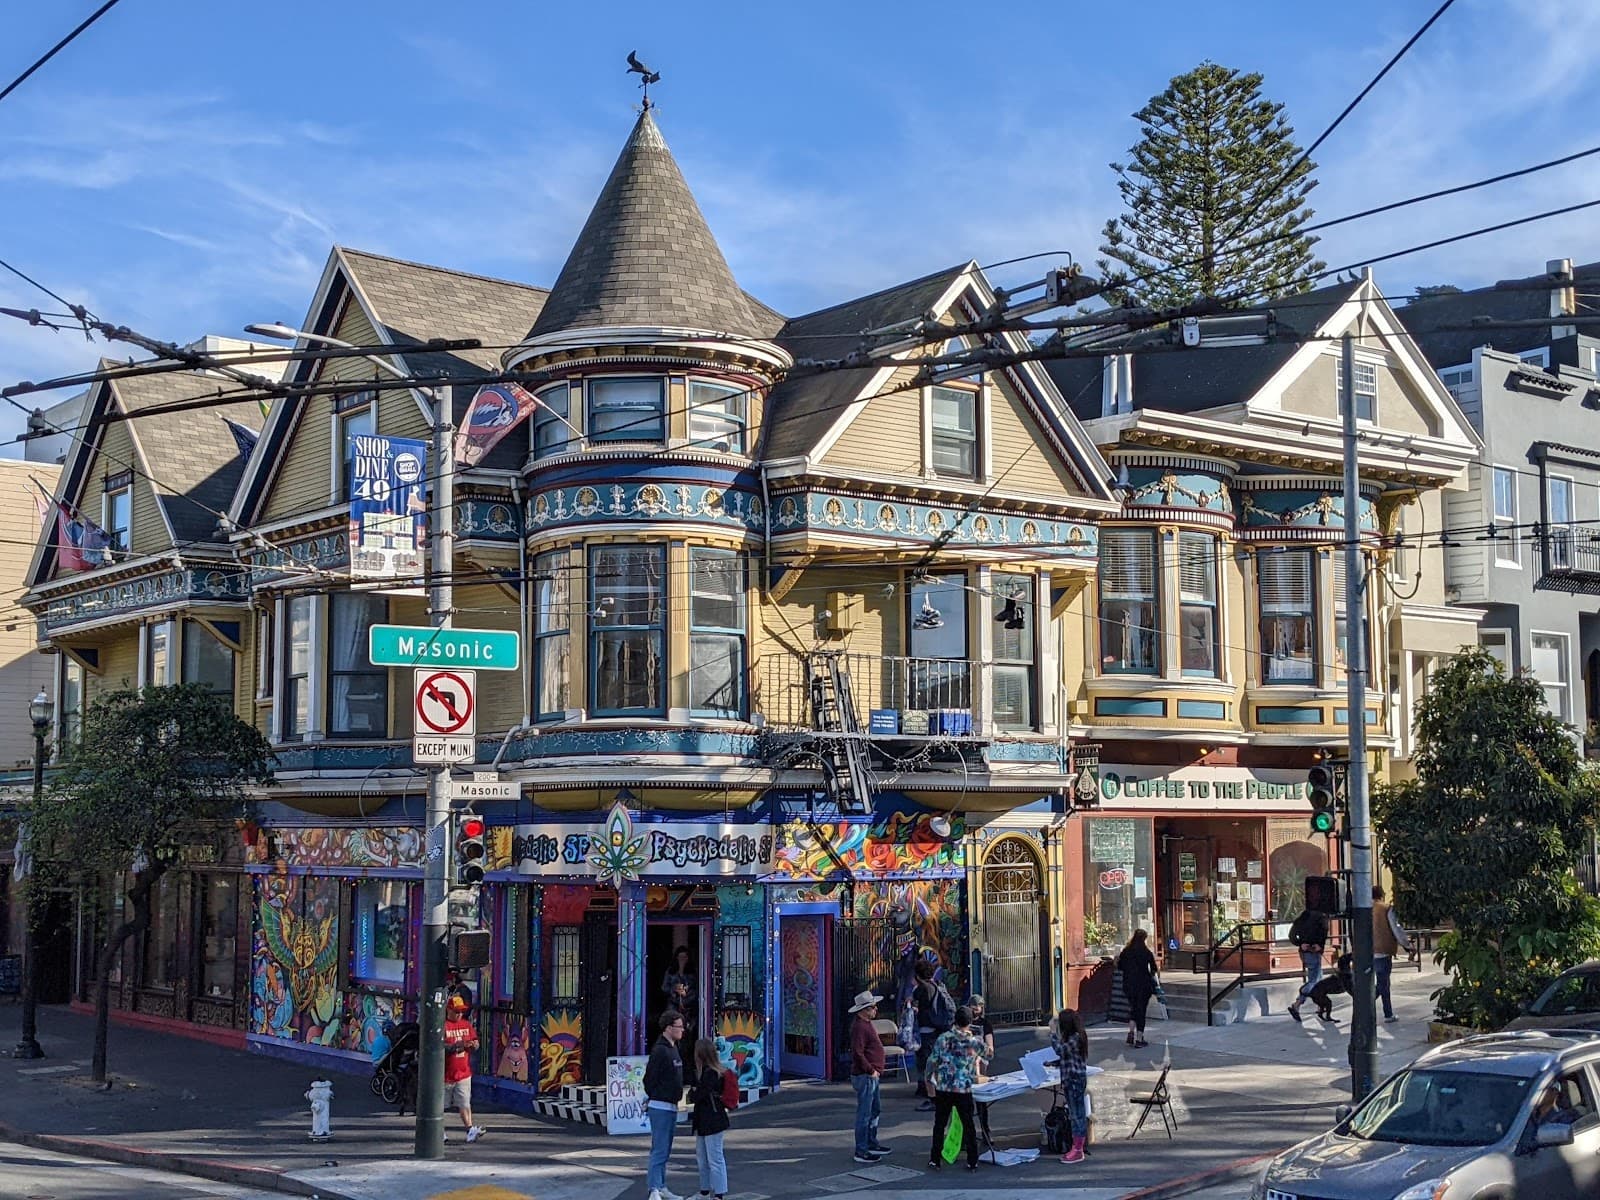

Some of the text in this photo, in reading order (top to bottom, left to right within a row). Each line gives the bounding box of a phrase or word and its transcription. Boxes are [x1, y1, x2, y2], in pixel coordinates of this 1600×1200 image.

[355, 435, 395, 459] SHOP &
[355, 456, 390, 480] DINE
[354, 479, 391, 502] 49
[398, 636, 494, 660] Masonic
[417, 743, 471, 756] EXCEPT MUNI
[1074, 757, 1098, 766] COFFEE
[461, 785, 510, 796] Masonic
[1124, 776, 1303, 800] COFFEE TO THE PEOPLE
[651, 830, 756, 867] Psychedelic
[1100, 869, 1129, 887] OPEN
[610, 1079, 636, 1098] OPEN
